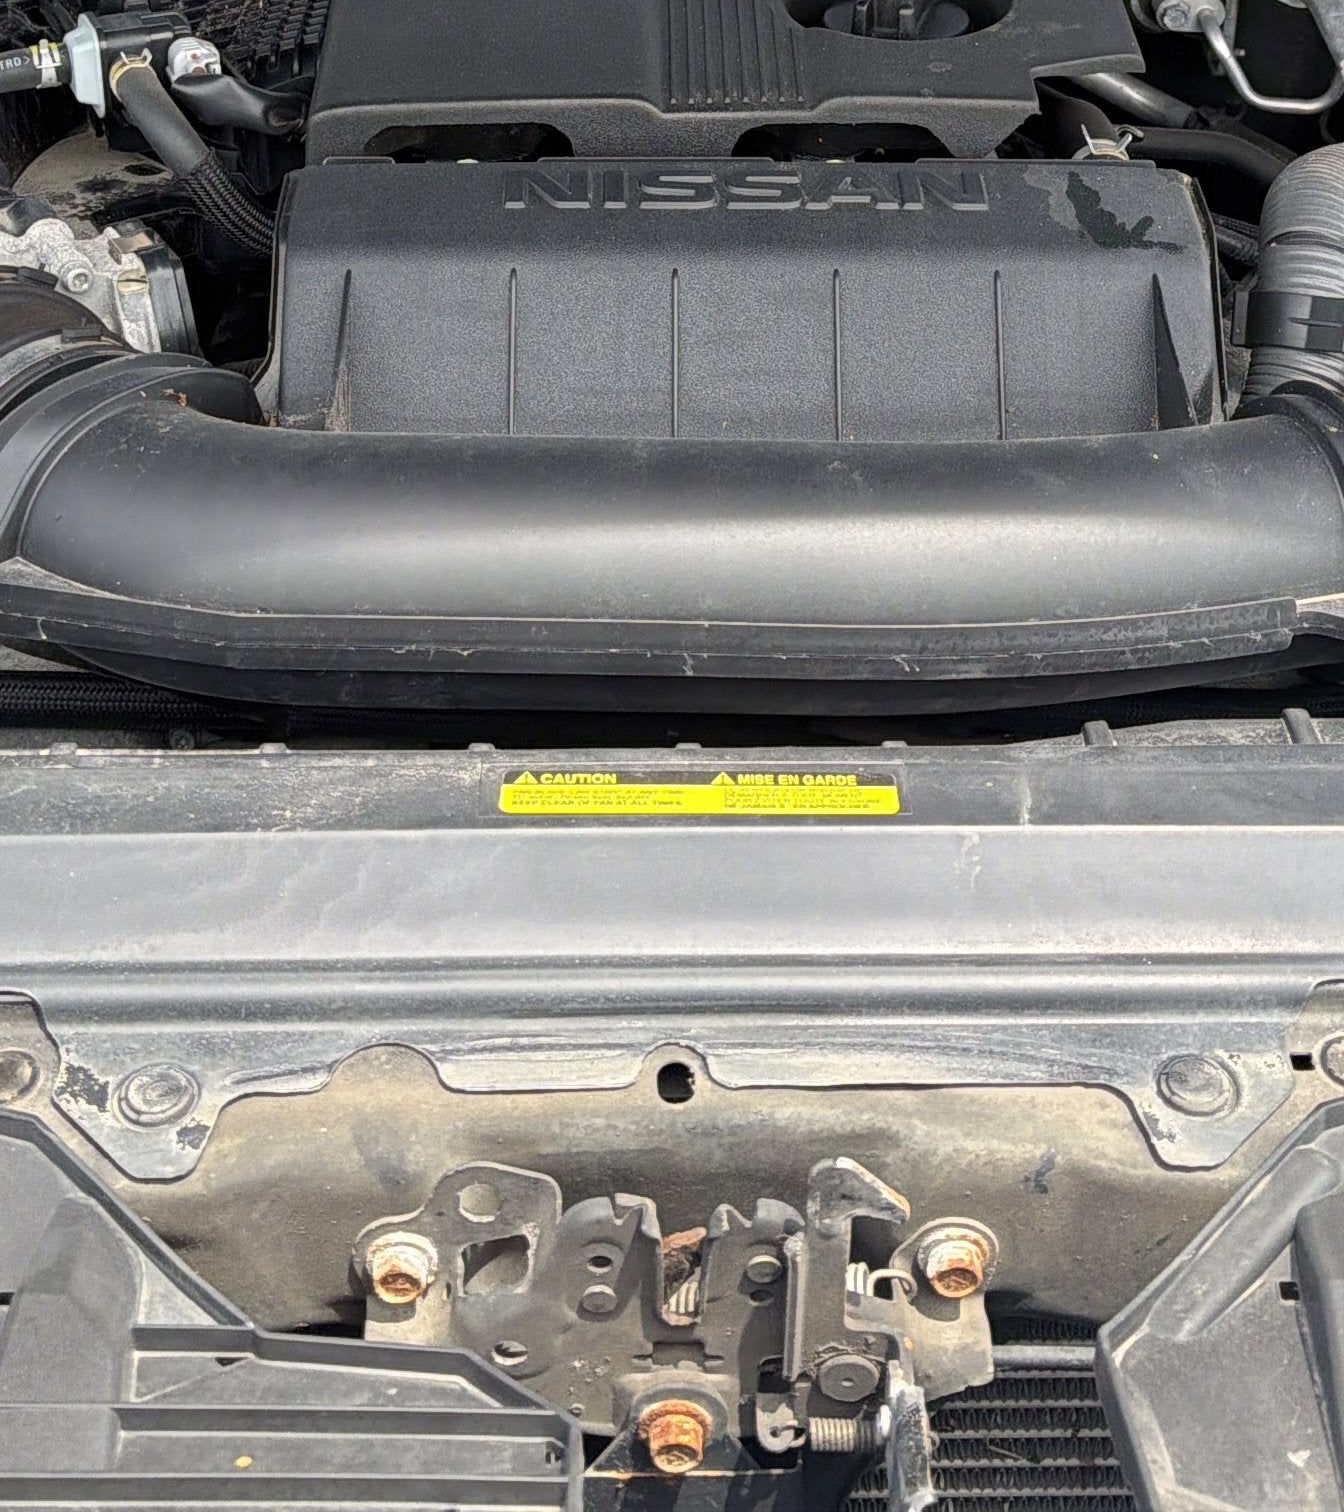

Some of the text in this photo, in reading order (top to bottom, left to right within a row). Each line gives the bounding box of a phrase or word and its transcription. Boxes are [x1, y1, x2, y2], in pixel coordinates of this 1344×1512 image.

[504, 169, 991, 212] NISSAN
[540, 773, 617, 784] CAUTION
[737, 774, 857, 786] MISE EN GARDE
